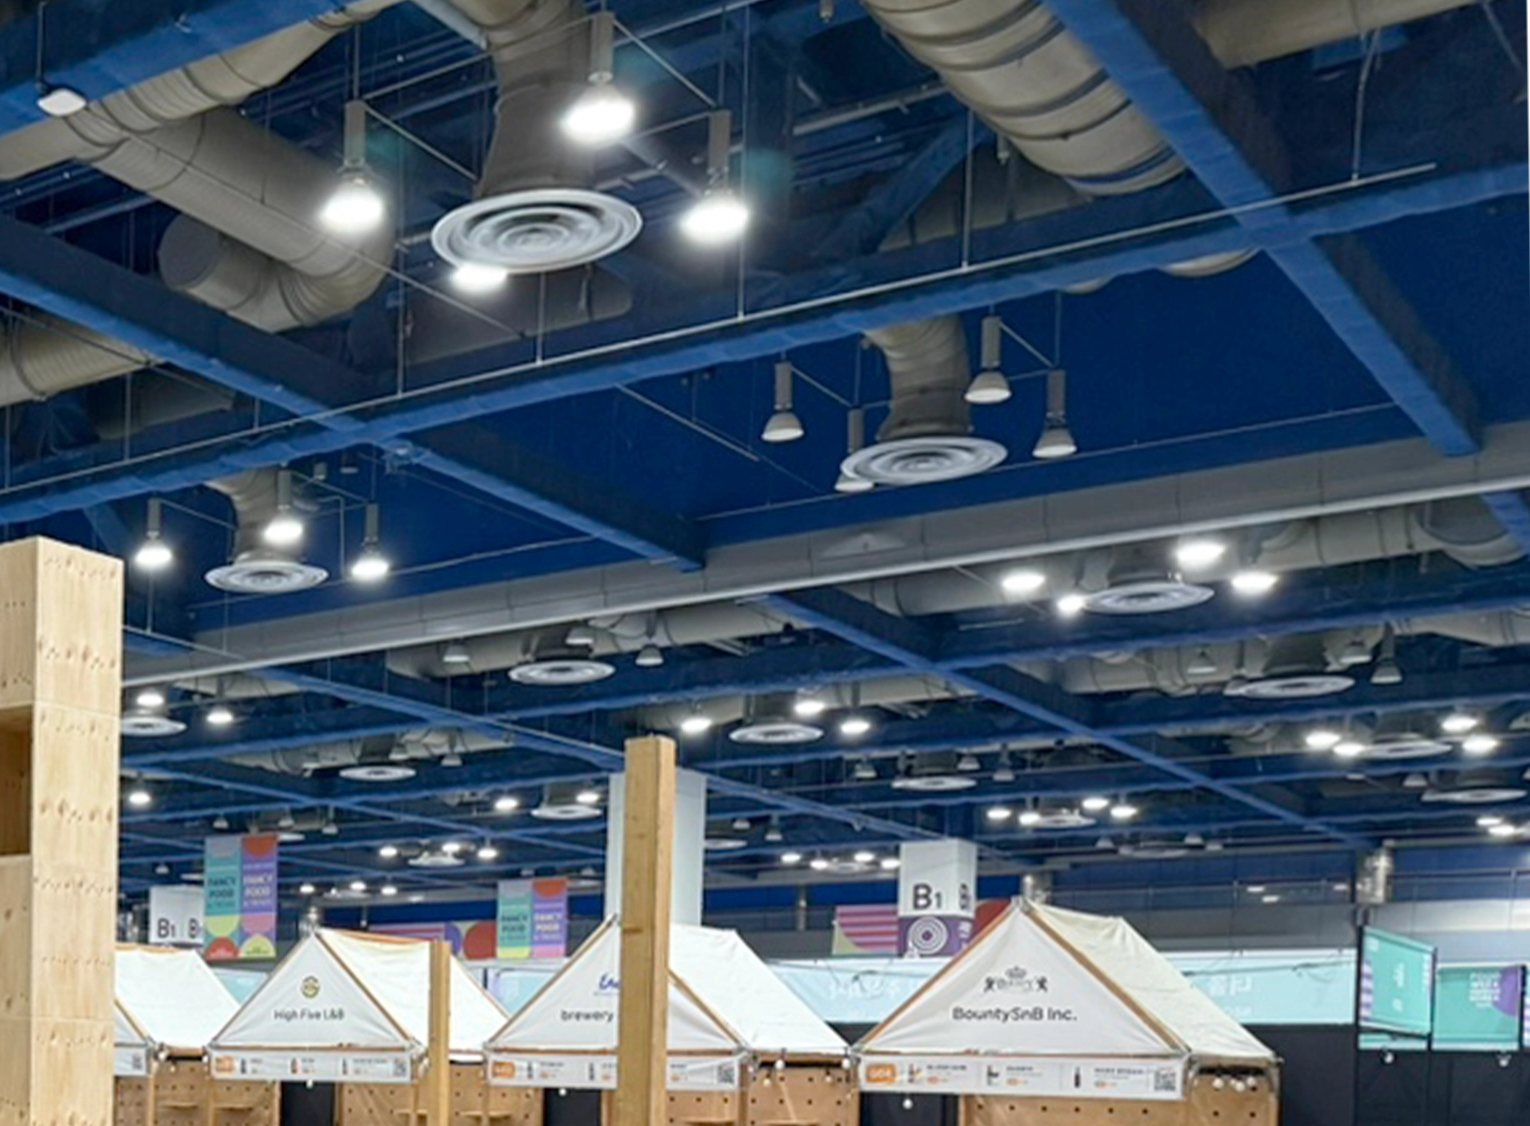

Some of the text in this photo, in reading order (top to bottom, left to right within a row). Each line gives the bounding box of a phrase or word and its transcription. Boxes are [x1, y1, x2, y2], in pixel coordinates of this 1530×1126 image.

[913, 883, 942, 910] B1
[158, 917, 175, 938] B1
[274, 1008, 298, 1022] High
[300, 1008, 321, 1020] Five
[561, 1010, 614, 1024] brewery
[952, 1006, 1077, 1023] BountySnB Inc.
